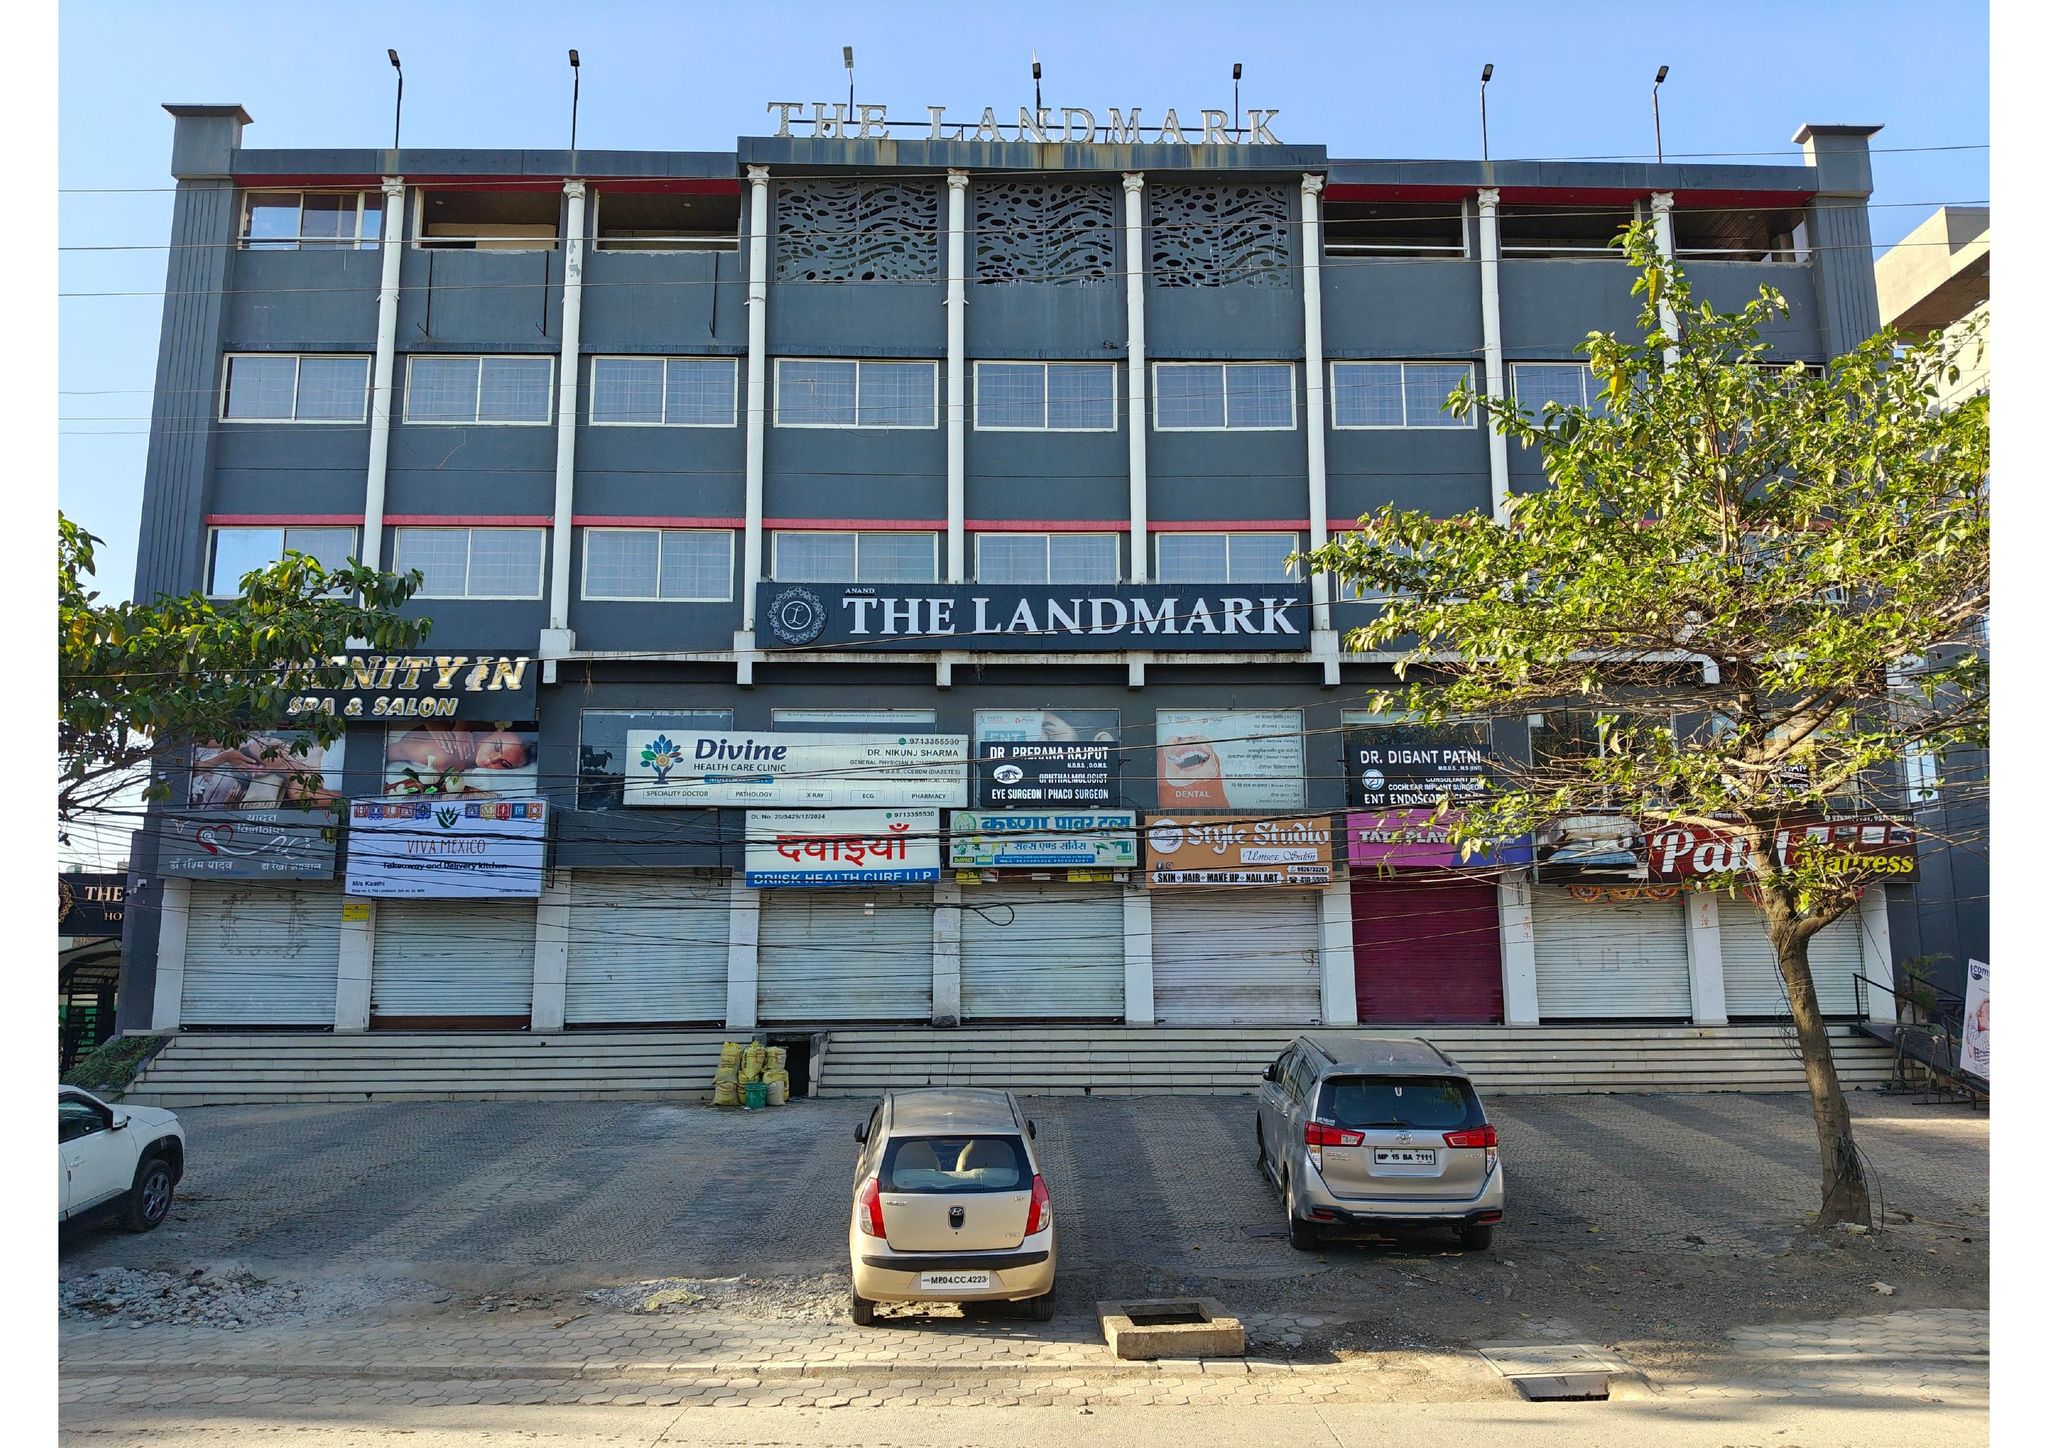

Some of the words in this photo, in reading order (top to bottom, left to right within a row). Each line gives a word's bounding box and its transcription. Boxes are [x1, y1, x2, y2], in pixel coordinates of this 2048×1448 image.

[767, 102, 889, 140] THE
[927, 106, 1283, 147] LANDMARK
[843, 597, 955, 635] THE
[971, 597, 1300, 636] LANDMARK
[286, 696, 335, 716] SPA
[344, 696, 364, 716] &
[372, 696, 459, 717] SALON
[695, 738, 788, 761] Divine
[867, 749, 882, 757] DR.
[885, 749, 918, 757] NIKUNJ
[920, 749, 959, 757] SHARMA
[1012, 746, 1064, 760] PRERANA
[1067, 746, 1109, 760] RAJPUT
[1360, 750, 1383, 764] DR.
[1388, 750, 1439, 764] DIGANT
[1443, 750, 1482, 764] PATNI
[693, 763, 729, 771] HEALTH
[731, 763, 755, 772] CARE
[756, 763, 787, 772] CLINIC
[1039, 773, 1108, 784] OPHTHALMOLOGIST
[992, 788, 1005, 800] EYE
[1007, 788, 1042, 800] SURGEON
[1048, 788, 1073, 800] PHACO
[1074, 788, 1109, 800] SURGEON
[1175, 790, 1210, 798] DENTAL
[1388, 783, 1423, 791] COCHLEAR
[1453, 783, 1484, 791] SURGEON
[1364, 793, 1385, 804] ENT
[894, 810, 935, 818] 9713355530
[1054, 816, 1095, 831] पावर
[1187, 821, 1247, 854] Style
[1253, 821, 1329, 845] Studio
[1359, 830, 1402, 844] TAT
[407, 839, 436, 854] VIVA
[440, 838, 486, 854] MEXICO
[776, 823, 910, 867] दवाइयाँ
[1242, 851, 1280, 862] Unisex
[1283, 851, 1317, 862] Salon
[1157, 873, 1176, 883] SKIN
[1182, 873, 1201, 883] HAIR
[1206, 873, 1228, 883] MAKE
[1229, 873, 1240, 883] UP
[1246, 873, 1264, 883] NAIL
[1264, 873, 1279, 883] ART
[85, 886, 124, 902] THE
[1377, 1153, 1389, 1161] MP
[1391, 1153, 1400, 1161] 15
[1402, 1153, 1413, 1161] BA
[1415, 1153, 1434, 1162] 7111
